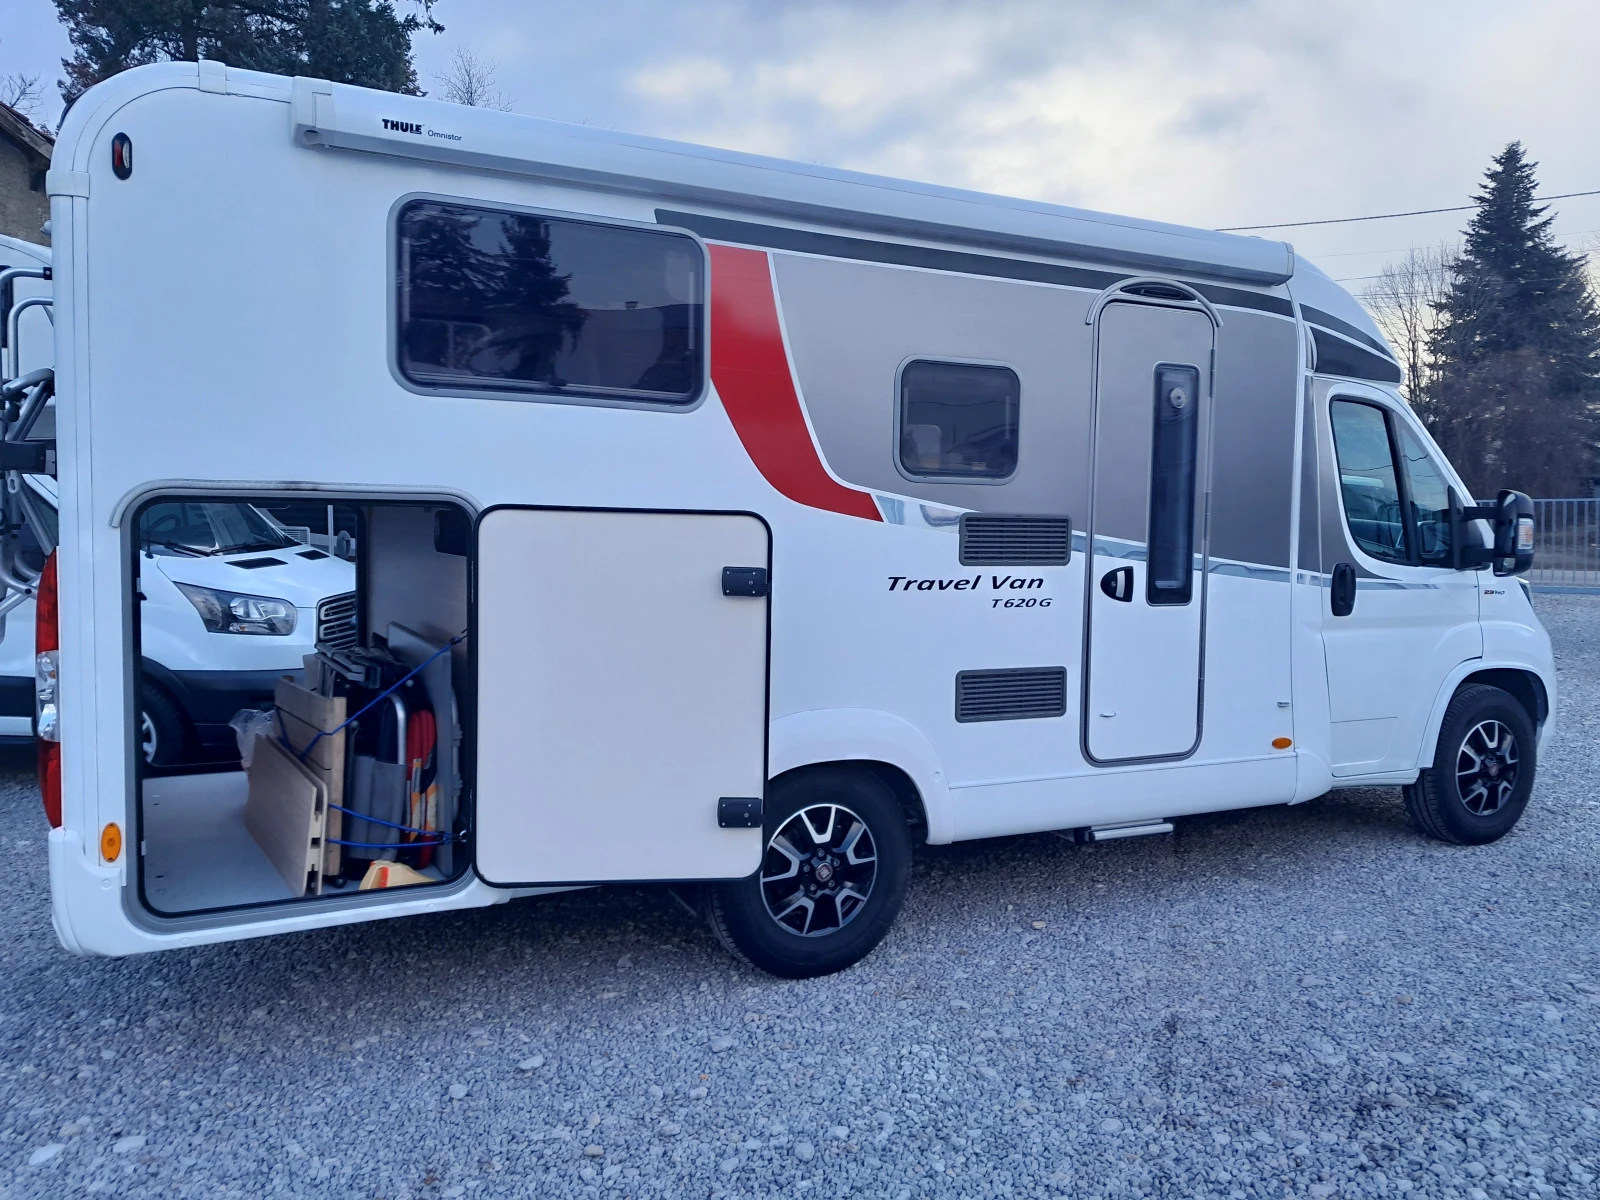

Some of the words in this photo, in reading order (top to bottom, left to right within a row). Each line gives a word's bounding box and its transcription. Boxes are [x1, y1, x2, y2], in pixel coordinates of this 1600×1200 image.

[381, 118, 422, 135] THULE
[427, 129, 462, 141] Omnistor
[887, 575, 982, 591] Travel
[991, 575, 1044, 590] Van
